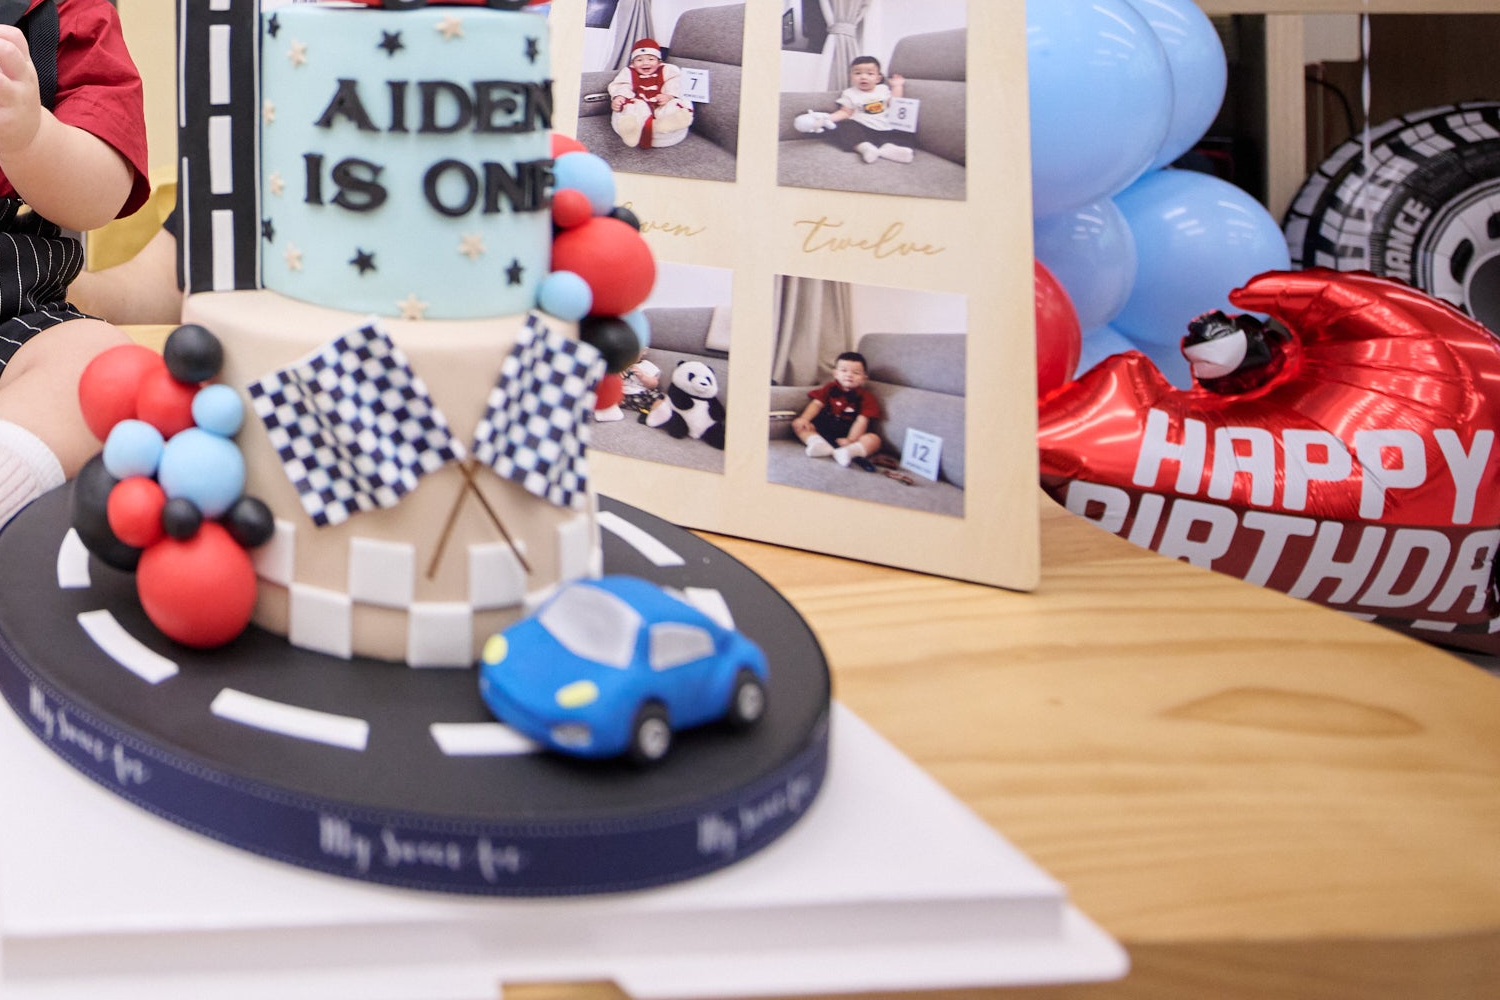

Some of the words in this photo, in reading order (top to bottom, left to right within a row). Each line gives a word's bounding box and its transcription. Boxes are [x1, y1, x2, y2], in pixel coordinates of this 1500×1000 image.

[313, 78, 554, 134] AIDEN
[690, 77, 698, 90] 7
[302, 153, 388, 212] IS
[422, 158, 556, 218] ONE
[794, 216, 947, 260] twelve
[912, 442, 930, 463] 12
[1132, 408, 1495, 525] HAPPY
